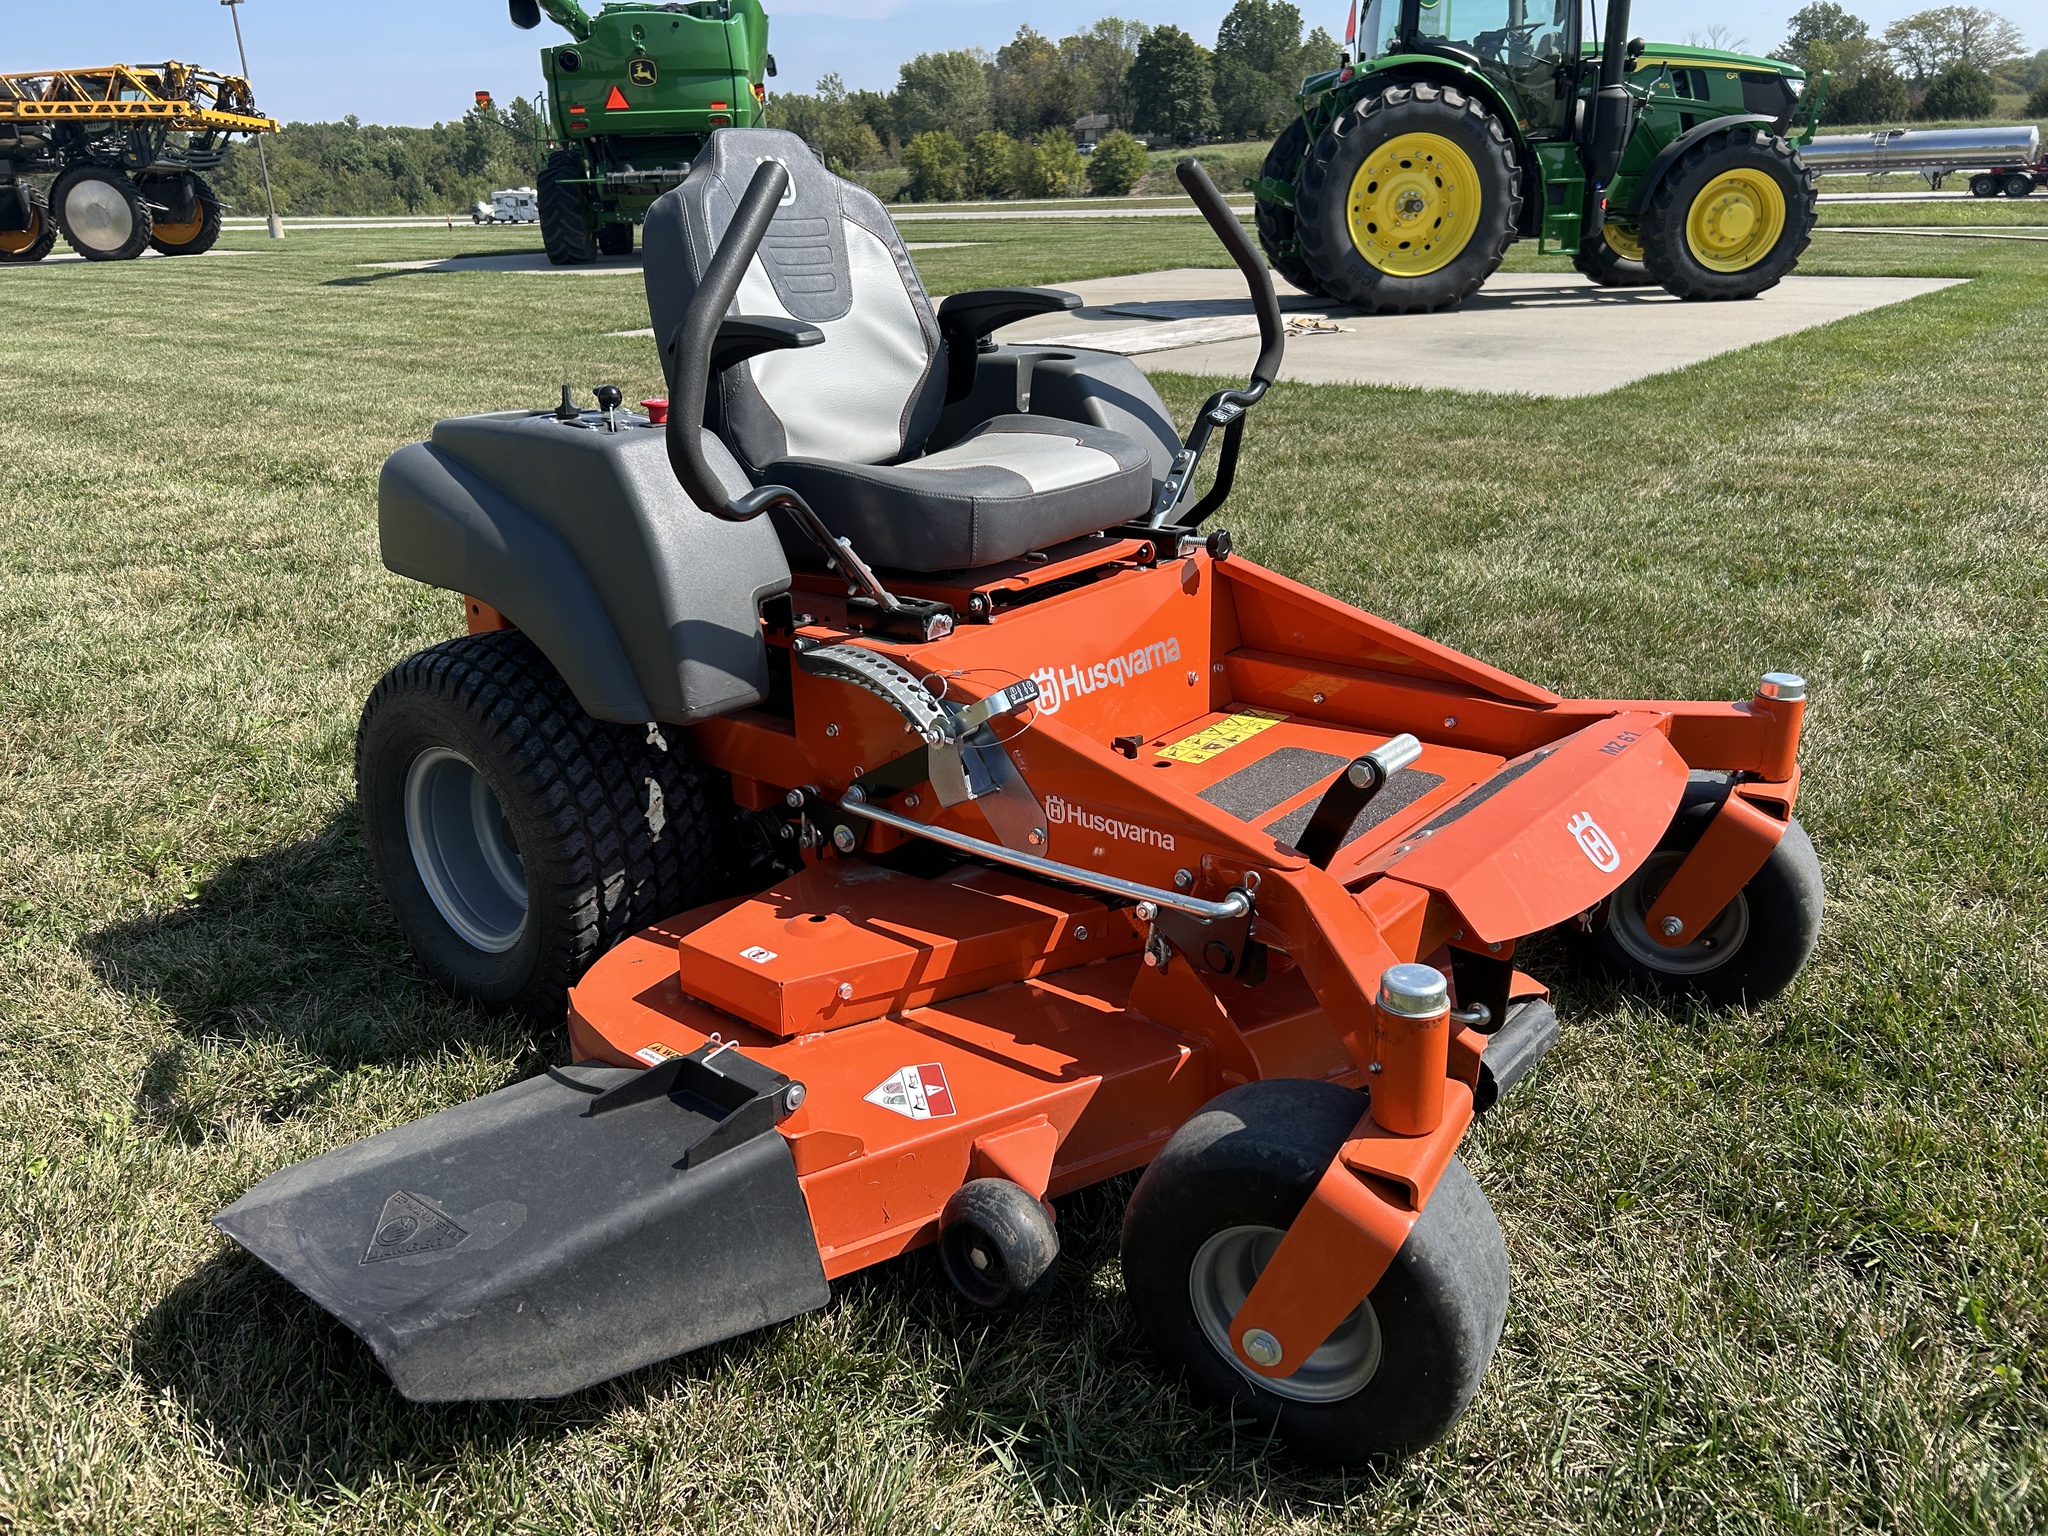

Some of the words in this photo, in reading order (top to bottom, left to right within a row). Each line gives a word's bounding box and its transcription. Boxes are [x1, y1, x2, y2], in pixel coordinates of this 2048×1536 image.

[1726, 72, 1738, 80] 6R
[1058, 637, 1181, 701] Husqvarna
[1598, 741, 1628, 756] MZ
[1617, 731, 1641, 743] 61
[1067, 803, 1175, 852] Husqvarna
